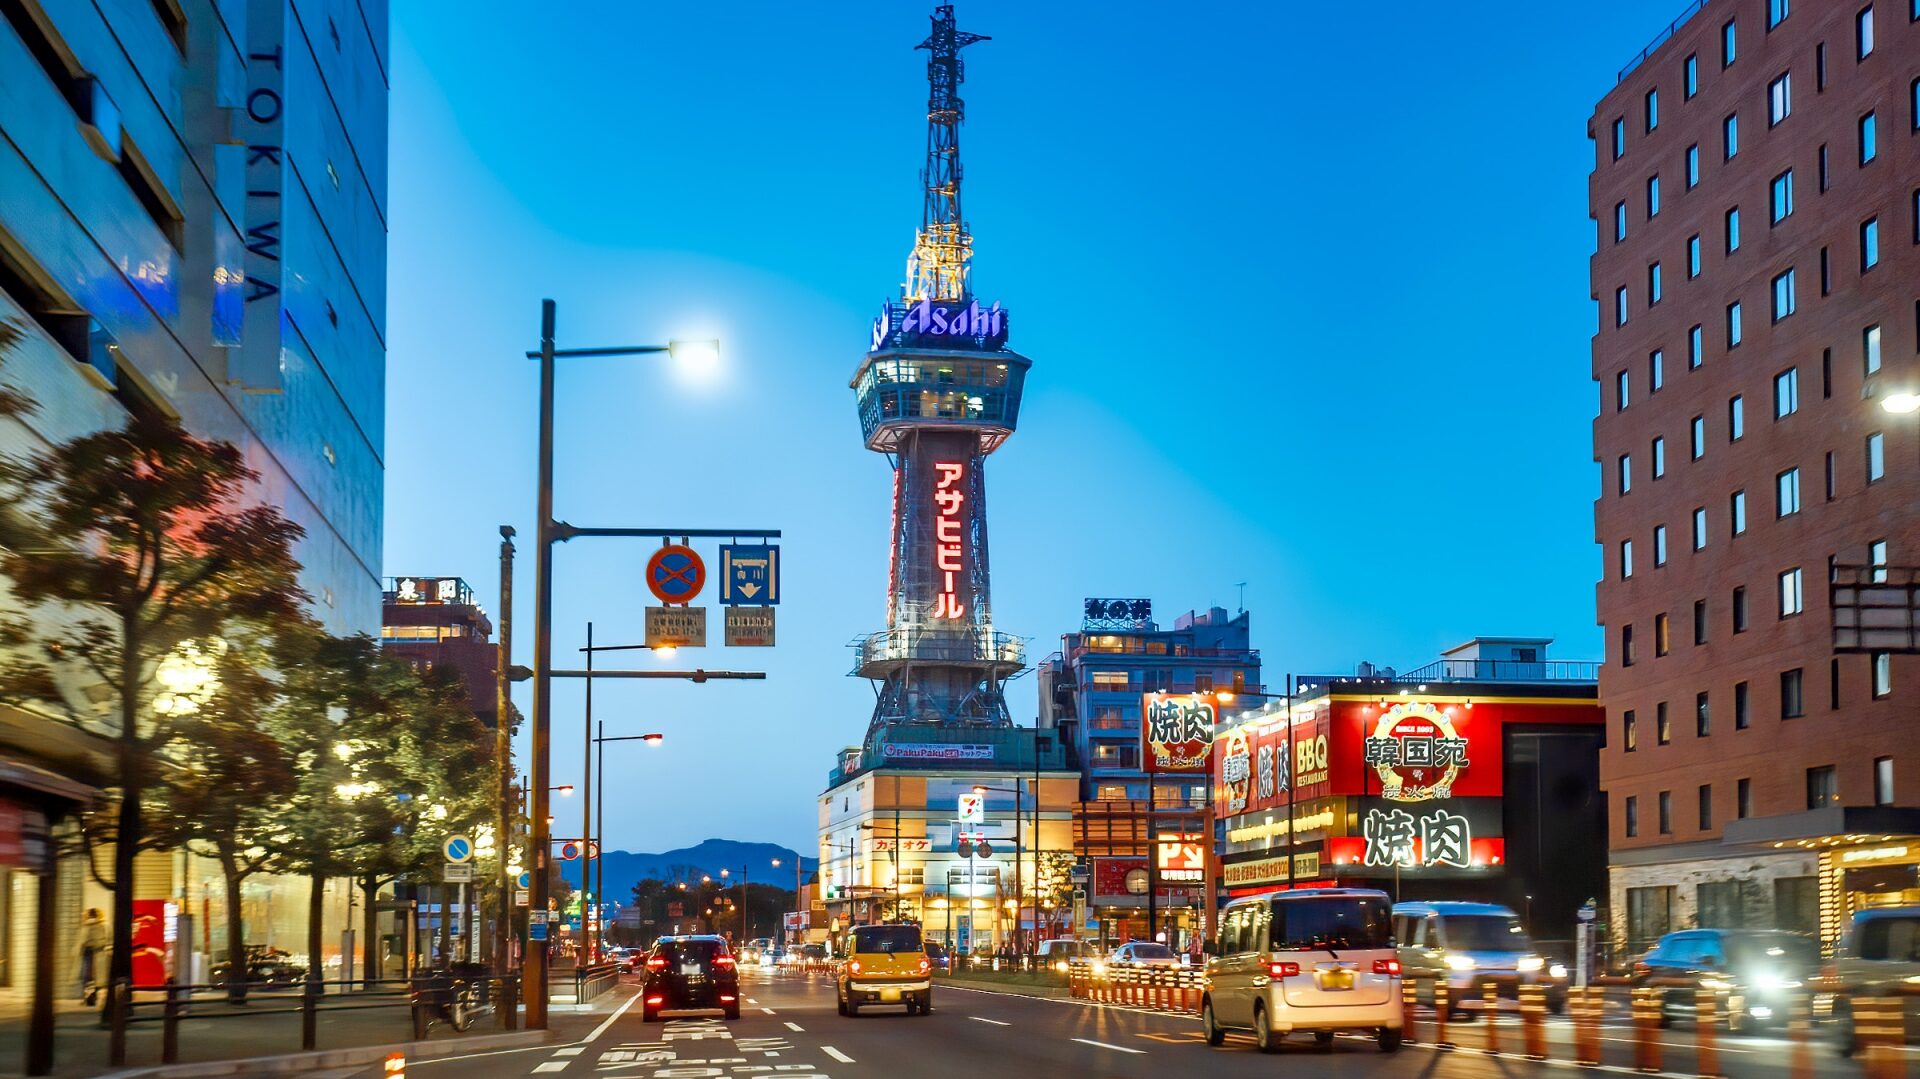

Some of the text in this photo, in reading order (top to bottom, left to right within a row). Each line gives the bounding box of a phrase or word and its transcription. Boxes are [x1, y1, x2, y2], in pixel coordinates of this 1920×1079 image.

[247, 44, 283, 304] TOKIWA
[902, 297, 1001, 337] Asahi
[934, 462, 965, 621] アサヒビール
[1147, 698, 1215, 745] 焼肉
[1297, 734, 1328, 773] BBQ
[1365, 736, 1470, 768] 韓国苑
[1297, 770, 1329, 788] RESTAURANT
[1363, 808, 1472, 868] 焼肉
